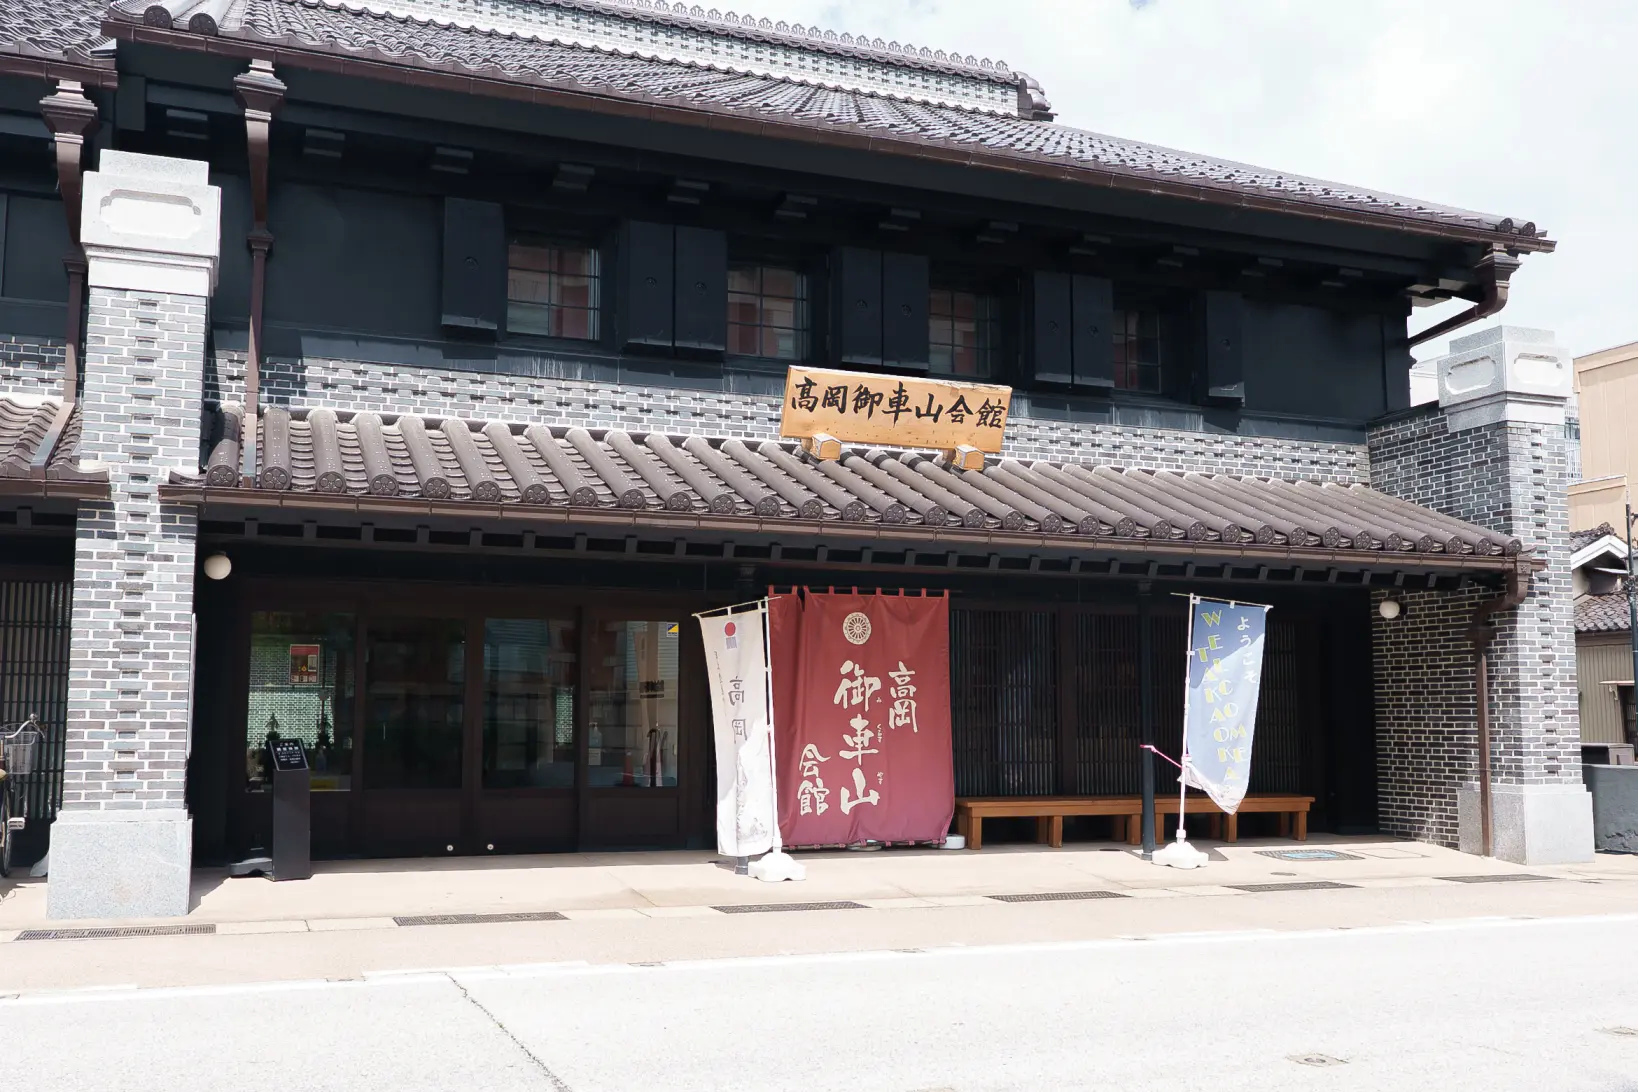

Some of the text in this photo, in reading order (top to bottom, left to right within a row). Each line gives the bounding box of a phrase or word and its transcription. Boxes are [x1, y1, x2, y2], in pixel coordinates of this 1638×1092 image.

[791, 375, 1007, 428] 高岡御車山会館
[1200, 609, 1249, 764] WELCOME
[1236, 616, 1258, 684] ようこそ
[728, 675, 748, 744] 高岡
[888, 660, 919, 733] 高岡
[833, 659, 882, 815] 御車山
[797, 743, 831, 816] 会館
